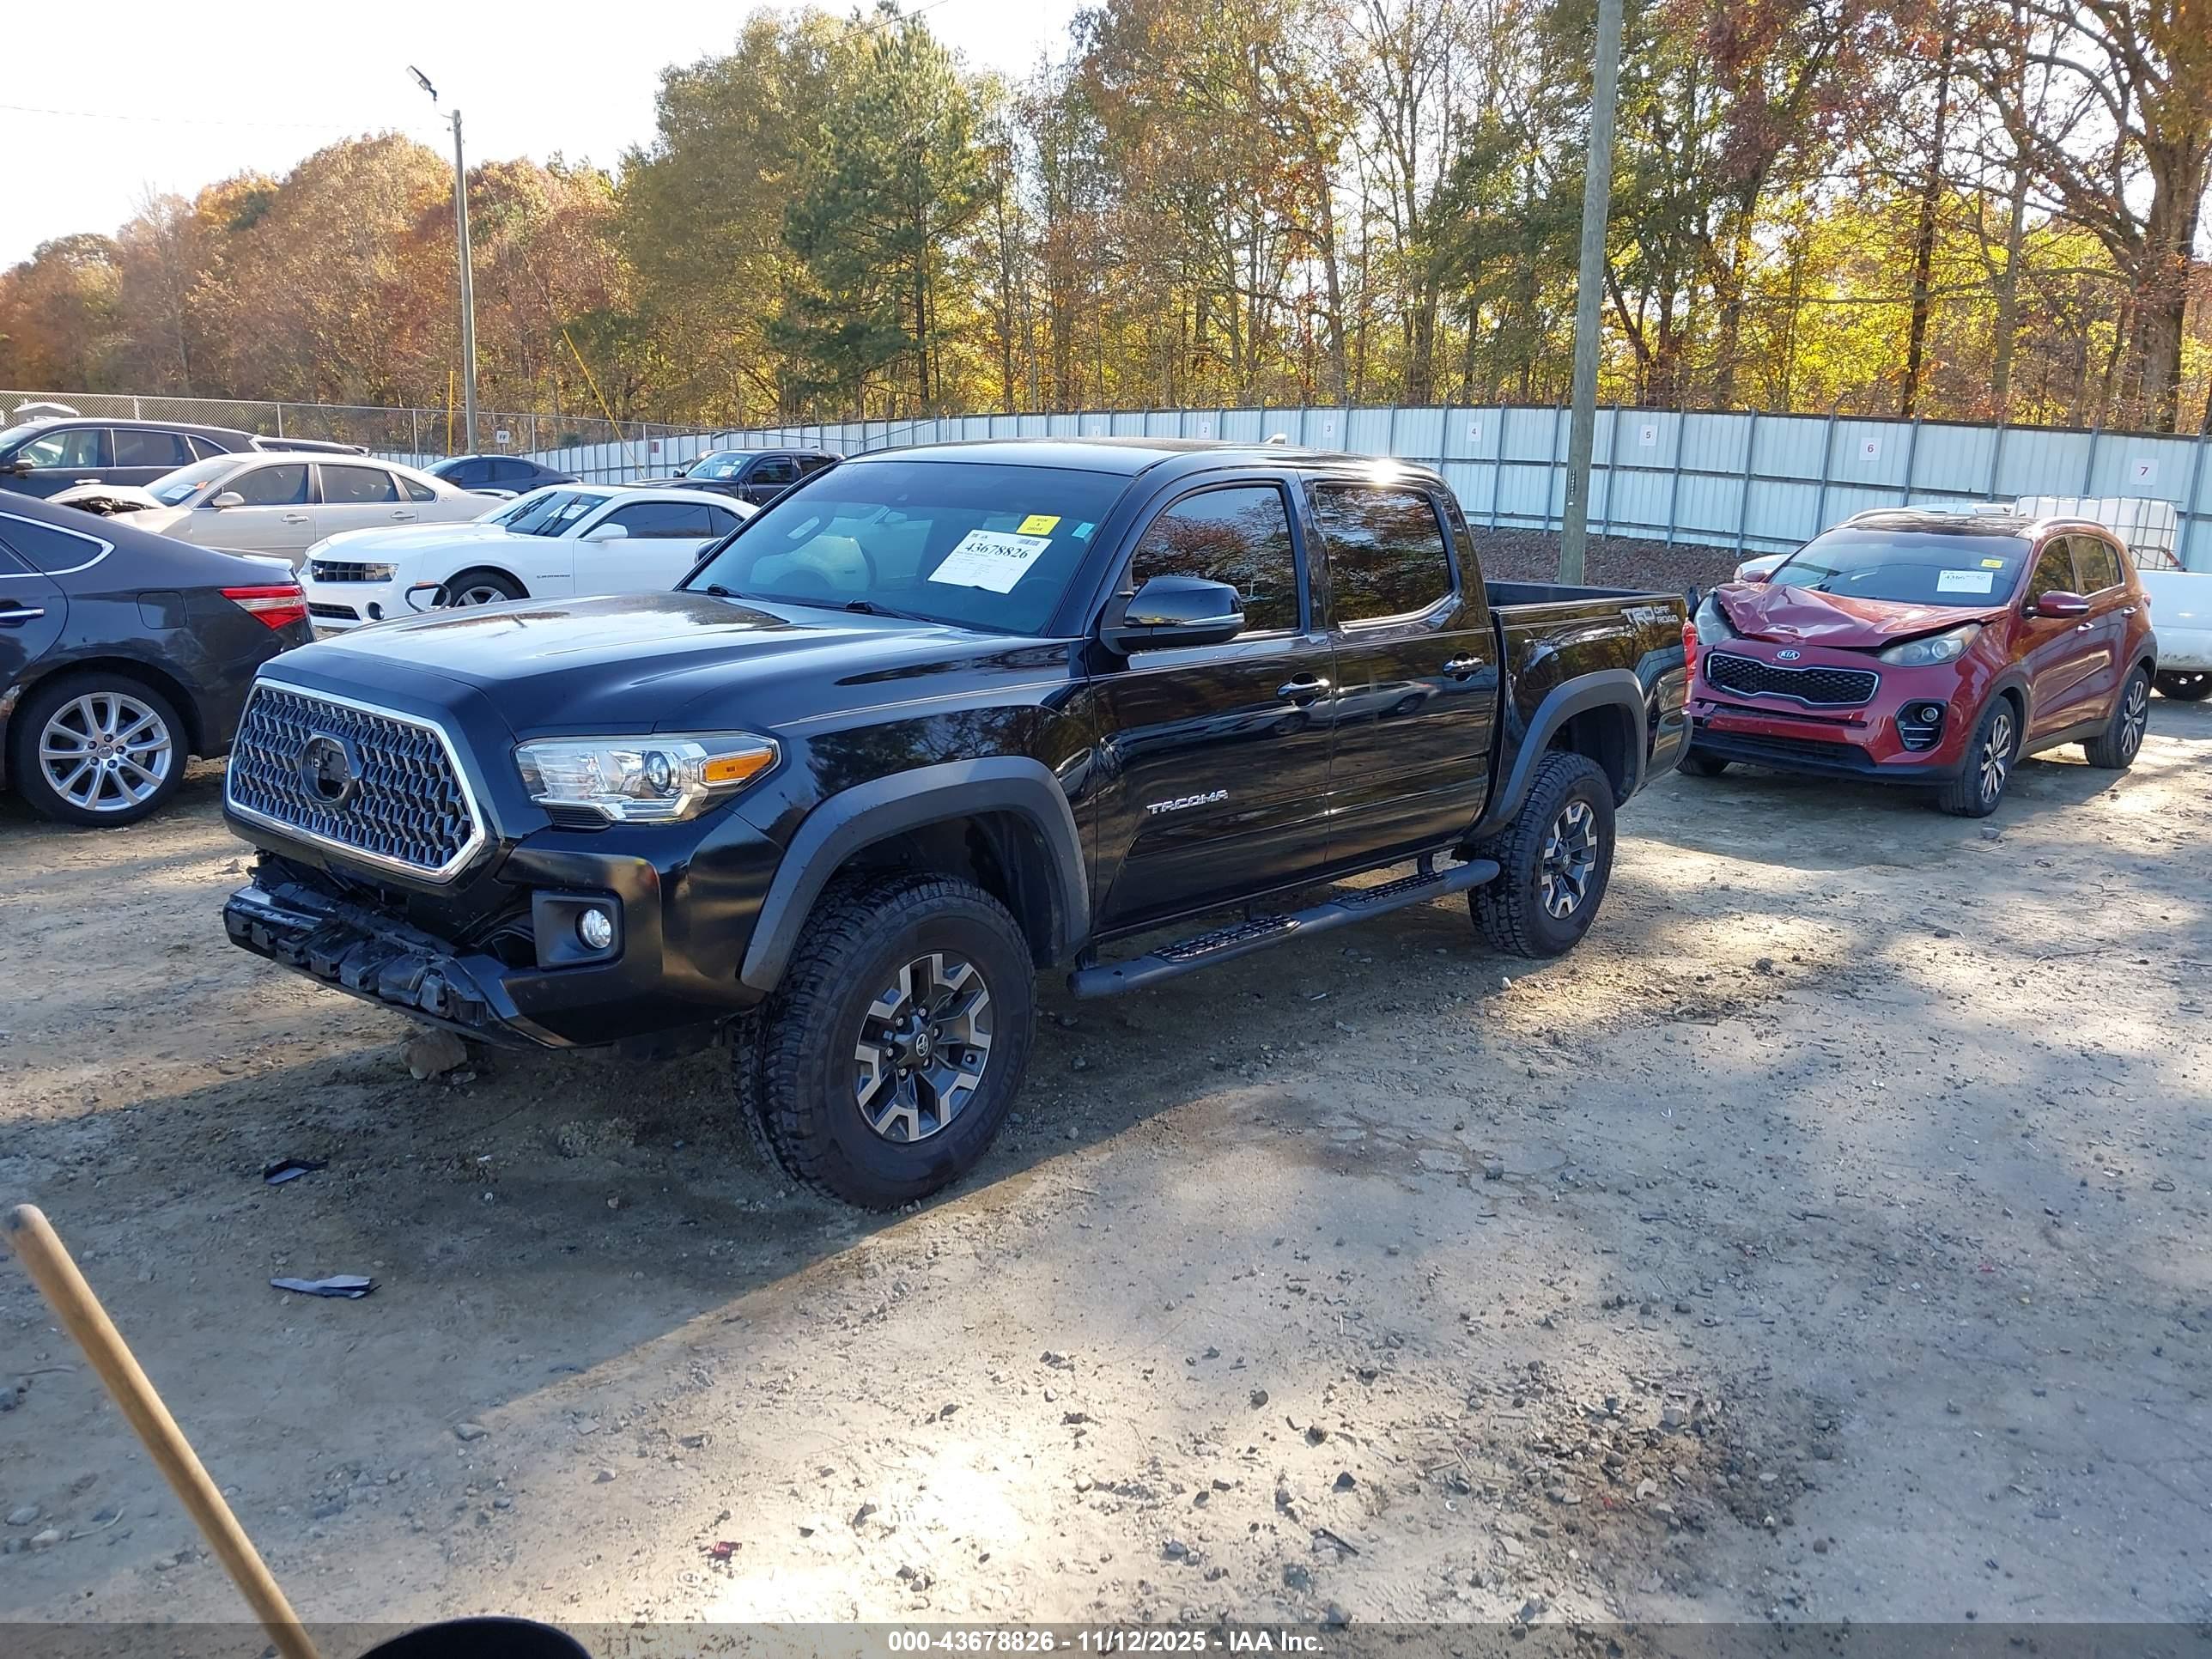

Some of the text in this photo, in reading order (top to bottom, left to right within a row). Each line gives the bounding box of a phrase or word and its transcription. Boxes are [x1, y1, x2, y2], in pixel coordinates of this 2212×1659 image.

[1645, 430, 1651, 440] 5
[1867, 444, 1875, 453] 6
[2140, 466, 2148, 476] 7
[965, 542, 1031, 558] 43678826
[1620, 606, 1656, 628] TRD
[1656, 614, 1679, 625] ROAD
[1779, 650, 1796, 659] KIA
[1146, 788, 1229, 815] TACOMA
